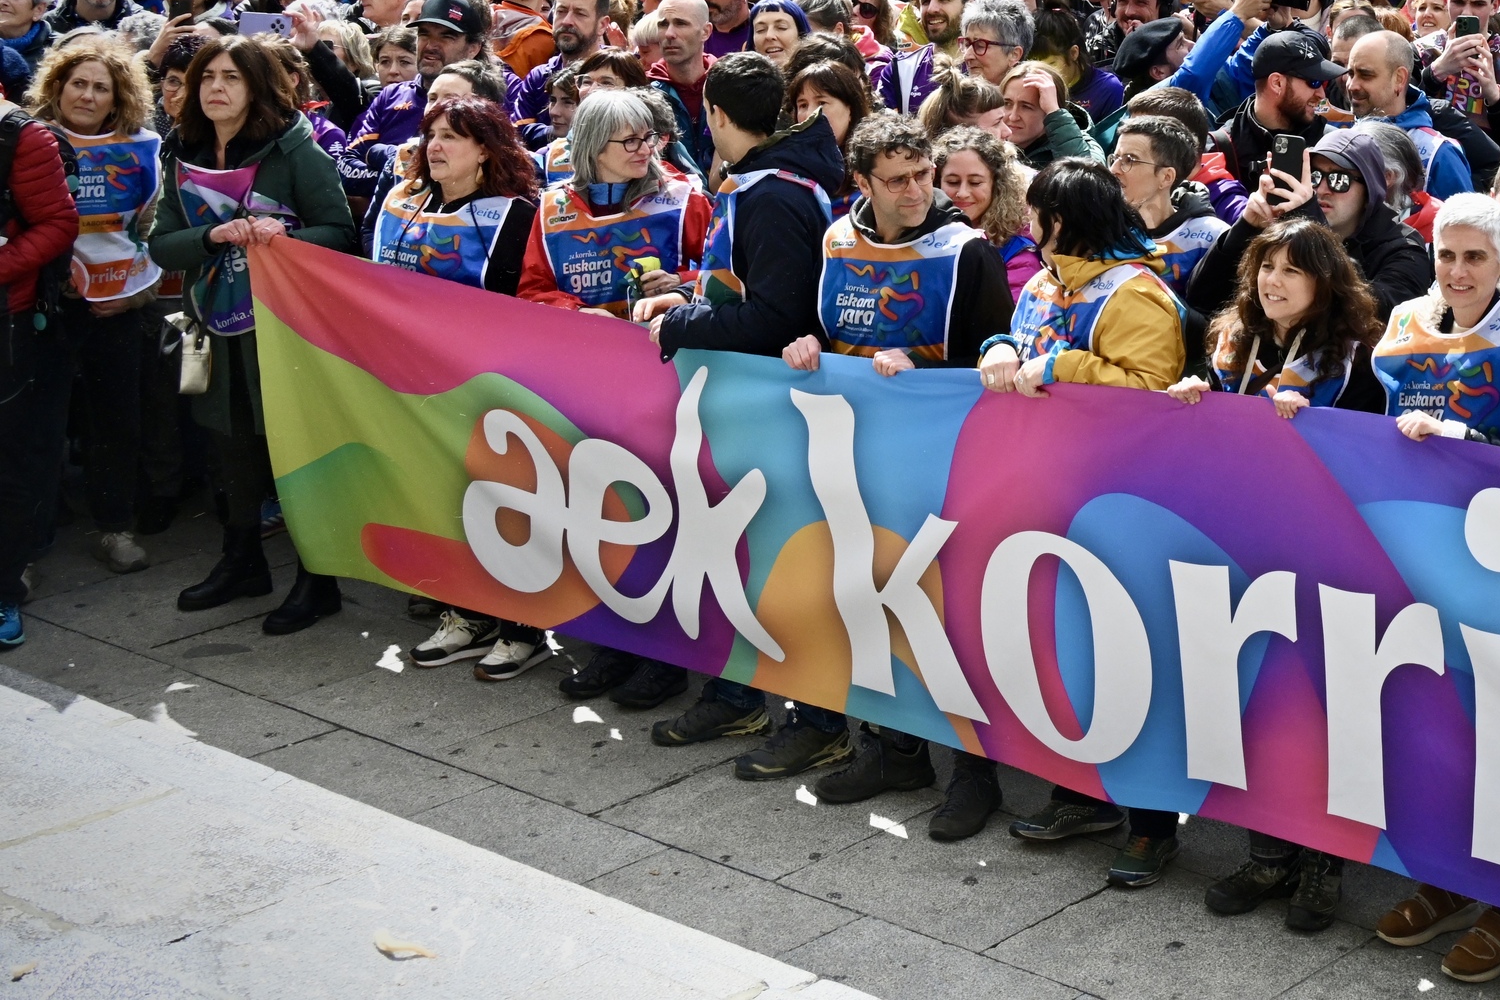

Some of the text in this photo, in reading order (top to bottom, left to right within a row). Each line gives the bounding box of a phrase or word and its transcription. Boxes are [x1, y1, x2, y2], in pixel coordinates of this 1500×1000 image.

[477, 208, 501, 221] eitb
[1190, 230, 1214, 243] eitb
[562, 258, 612, 275] Euskara
[570, 270, 613, 294] gara
[1398, 392, 1446, 407] Euskara
[462, 365, 785, 663] aek
